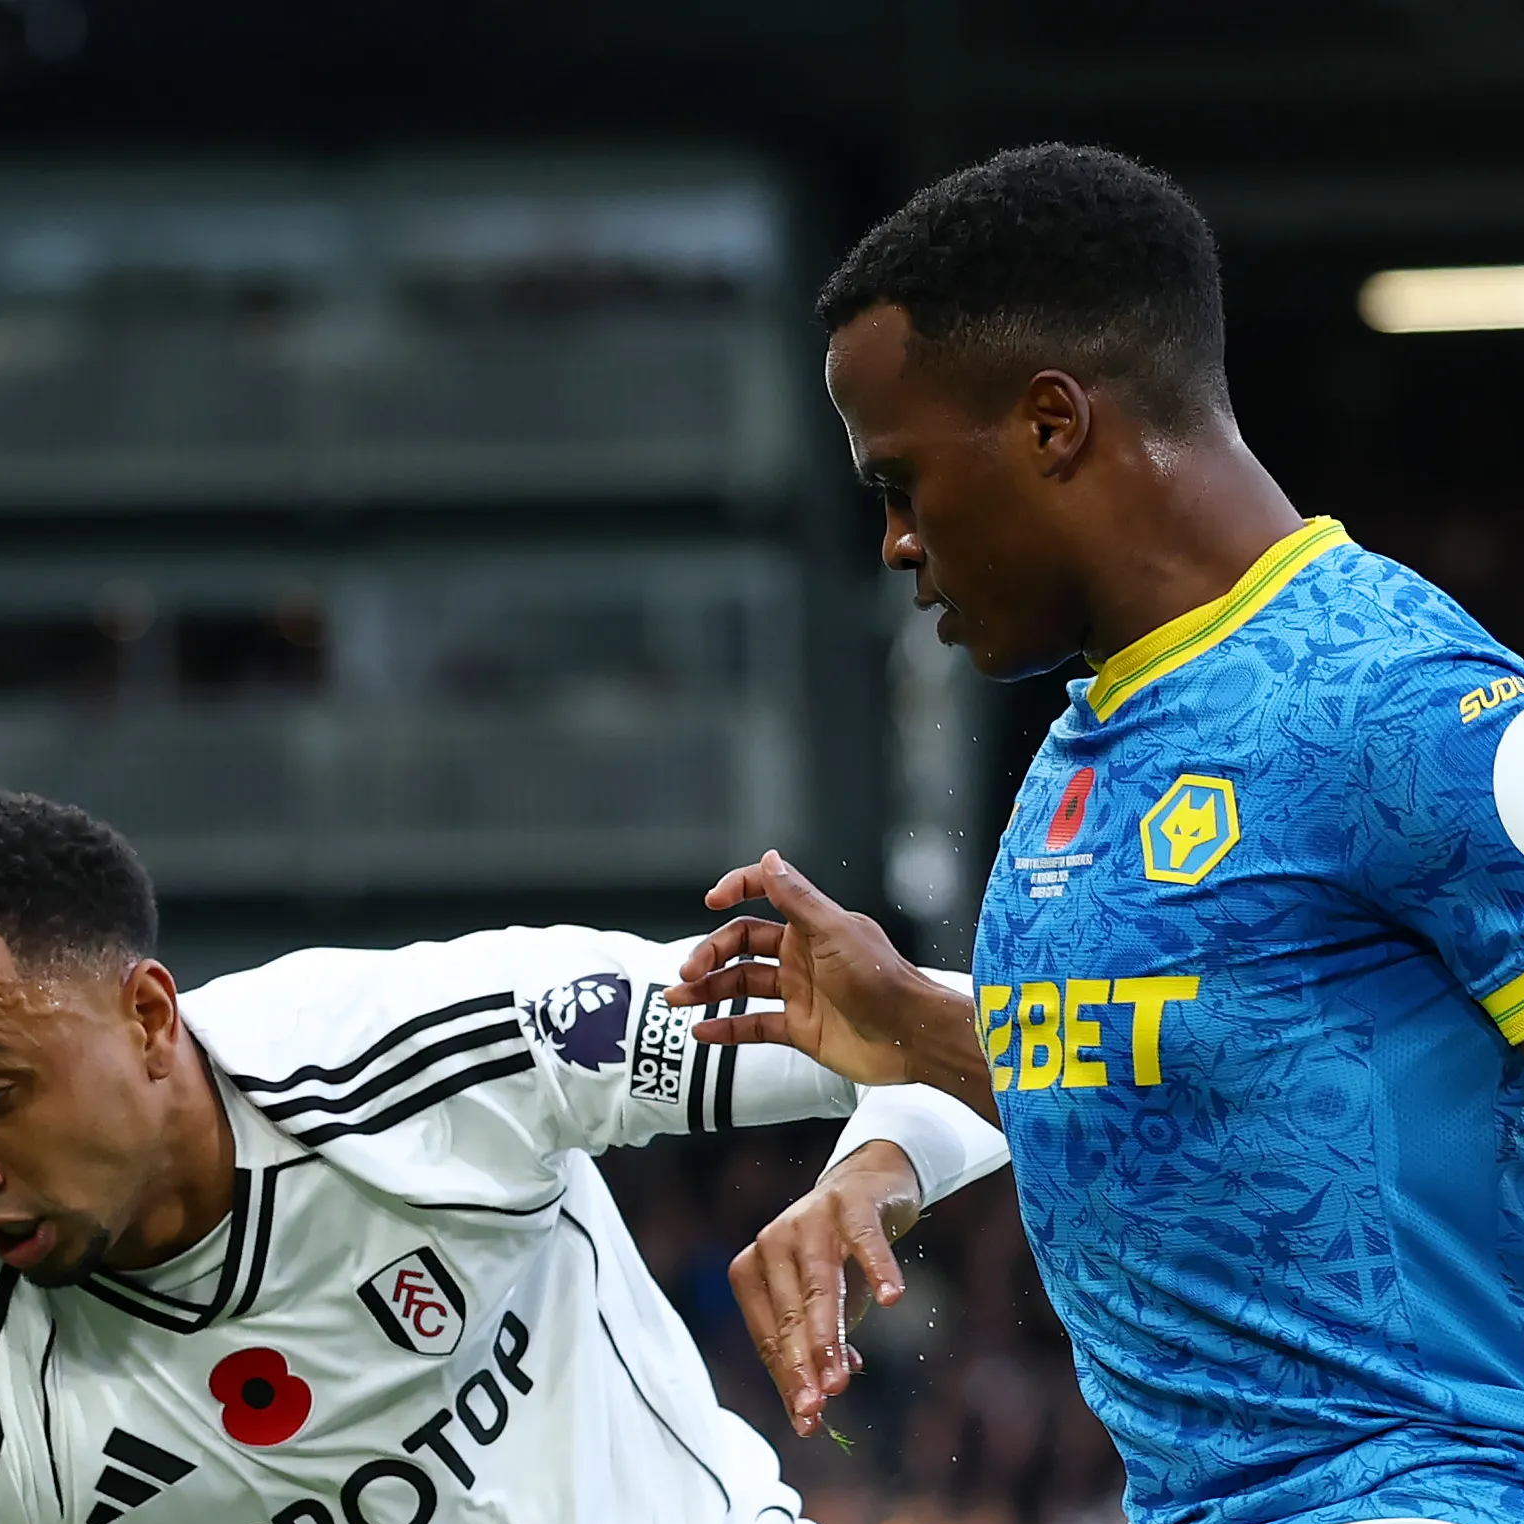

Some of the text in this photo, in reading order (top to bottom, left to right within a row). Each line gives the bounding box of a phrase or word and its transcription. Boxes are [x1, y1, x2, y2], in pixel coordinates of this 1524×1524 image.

[976, 976, 1201, 1092] EBET
[631, 1058, 659, 1099] No
[393, 1269, 448, 1338] FFC
